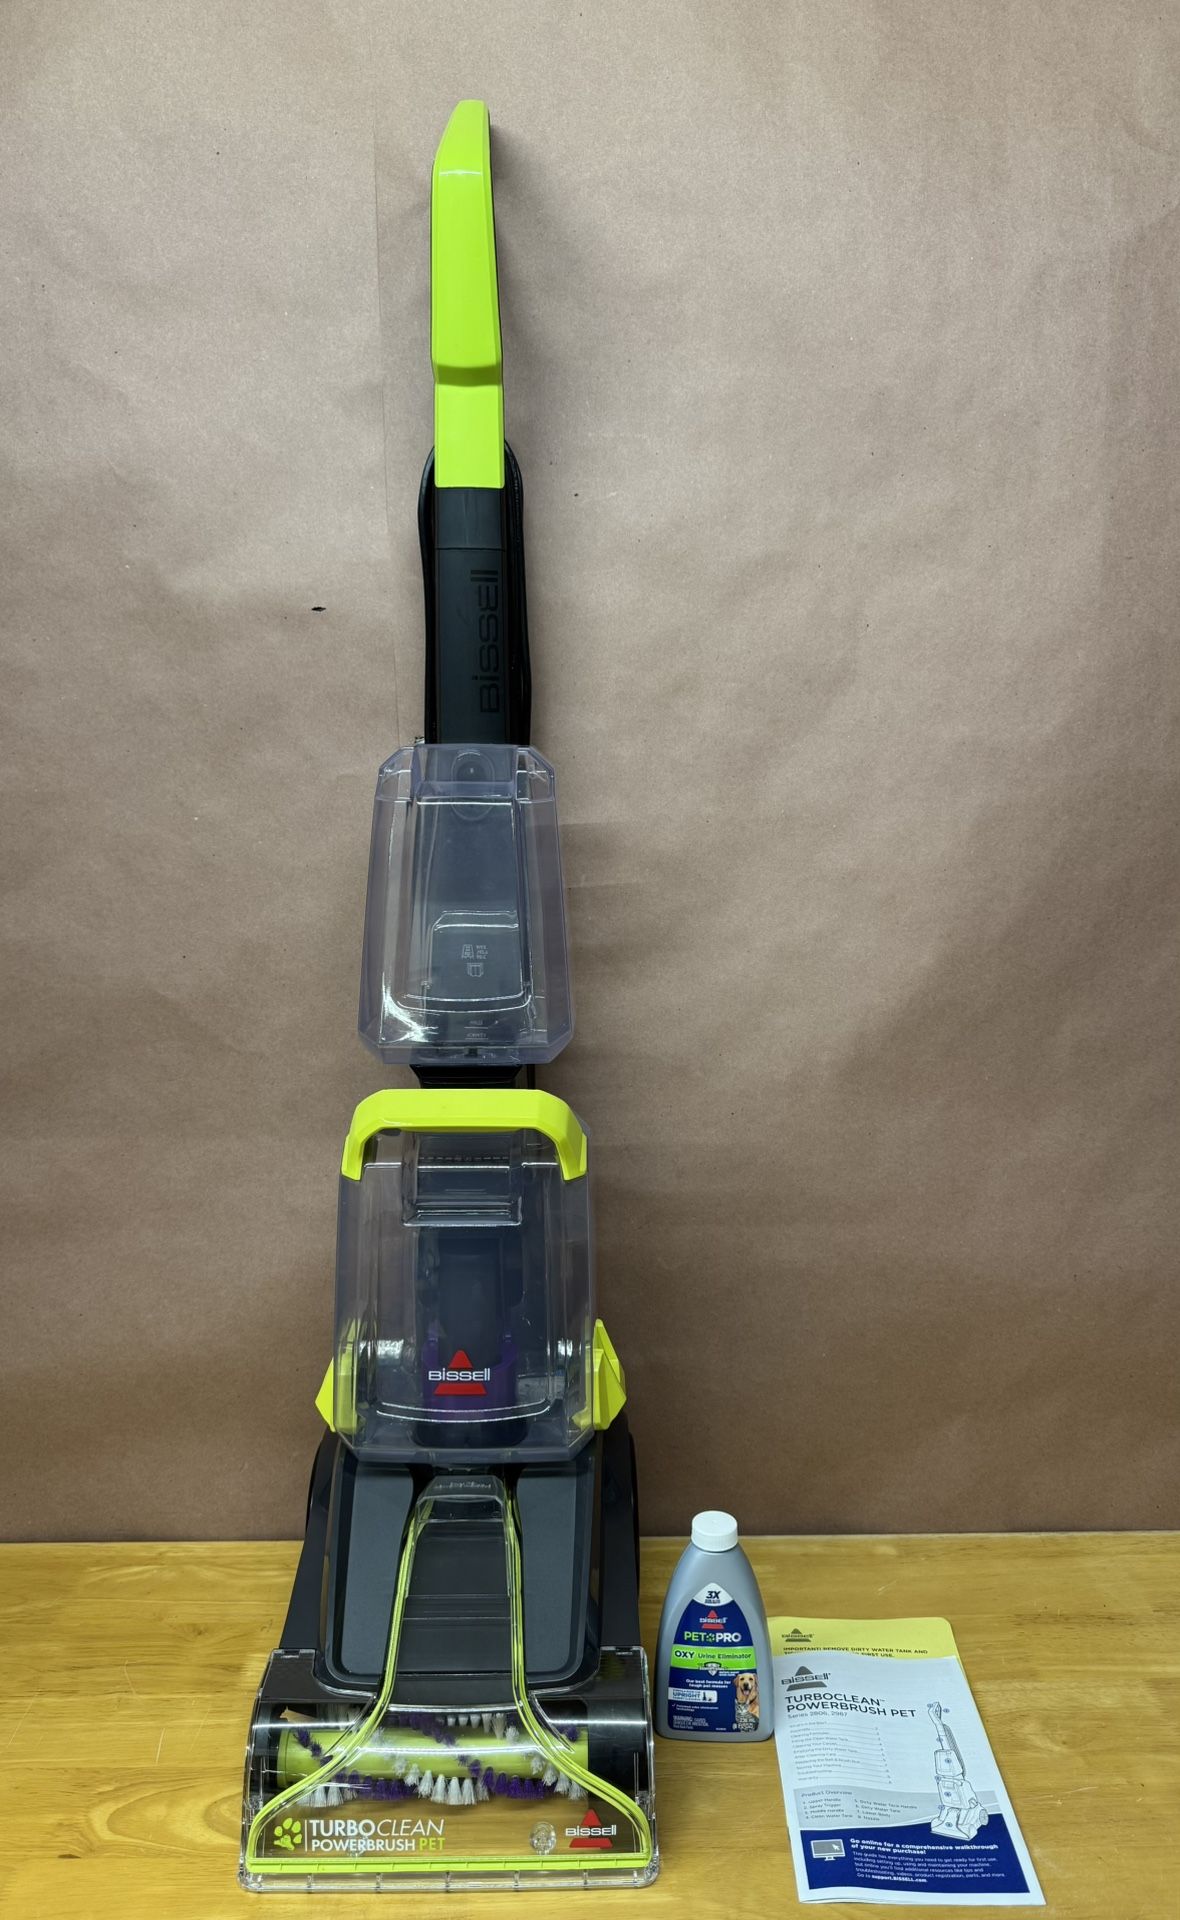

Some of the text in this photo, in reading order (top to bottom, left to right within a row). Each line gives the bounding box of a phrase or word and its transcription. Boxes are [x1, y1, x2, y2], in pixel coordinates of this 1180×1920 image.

[428, 1367, 490, 1381] BISSELL
[706, 1590, 721, 1600] 3X
[684, 1631, 742, 1642] PET PRO
[674, 1650, 694, 1658] OXY
[781, 1672, 829, 1685] BISSELL
[787, 1701, 916, 1717] POWERBRUSH PET
[565, 1824, 616, 1836] BISSELL
[311, 1838, 445, 1851] POWERBRUSH PET
